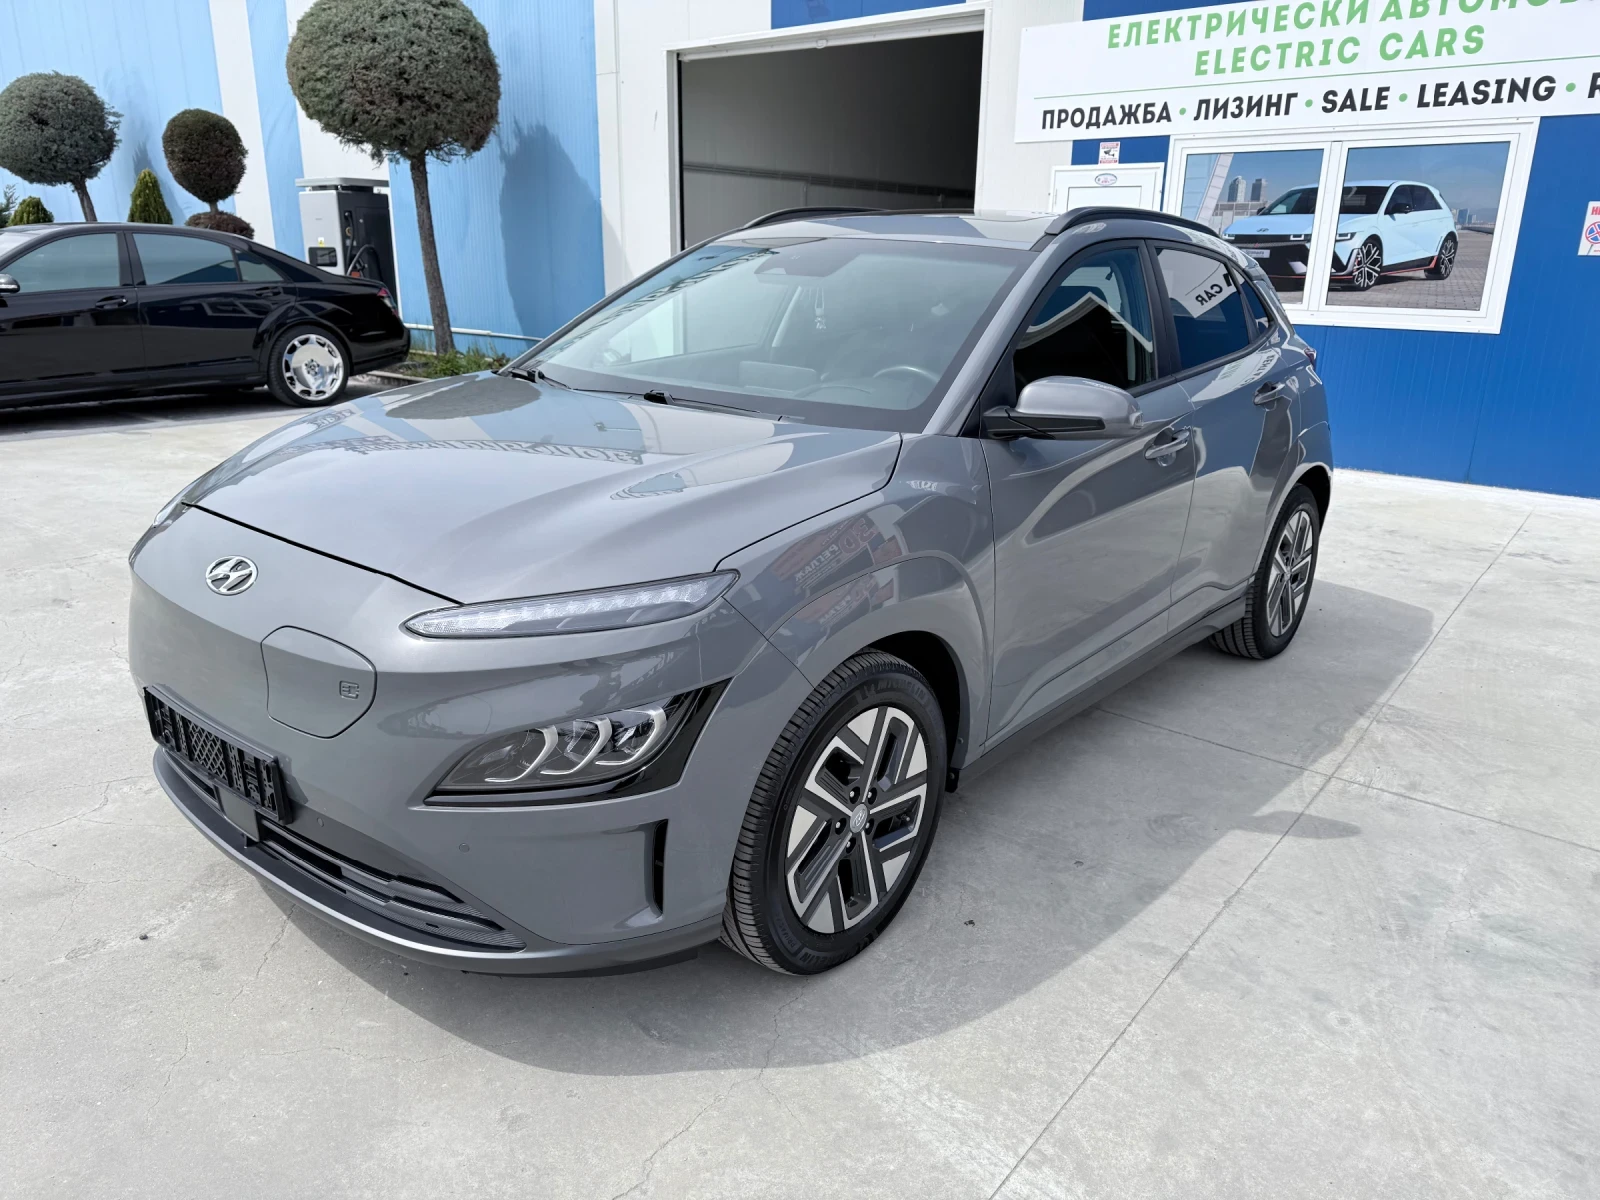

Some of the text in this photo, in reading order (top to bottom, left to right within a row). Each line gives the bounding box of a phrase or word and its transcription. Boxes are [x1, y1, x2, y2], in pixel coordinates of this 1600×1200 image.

[1107, 0, 1370, 49] ЕЛЕКТРИЧЕСКИ
[1195, 24, 1485, 76] ELECTRIC CARS
[1042, 101, 1173, 130] ПРОДАЖБА
[1193, 92, 1299, 121] ЛИЗИНГ
[1321, 86, 1391, 113] SALE
[1417, 75, 1556, 108] LEASING
